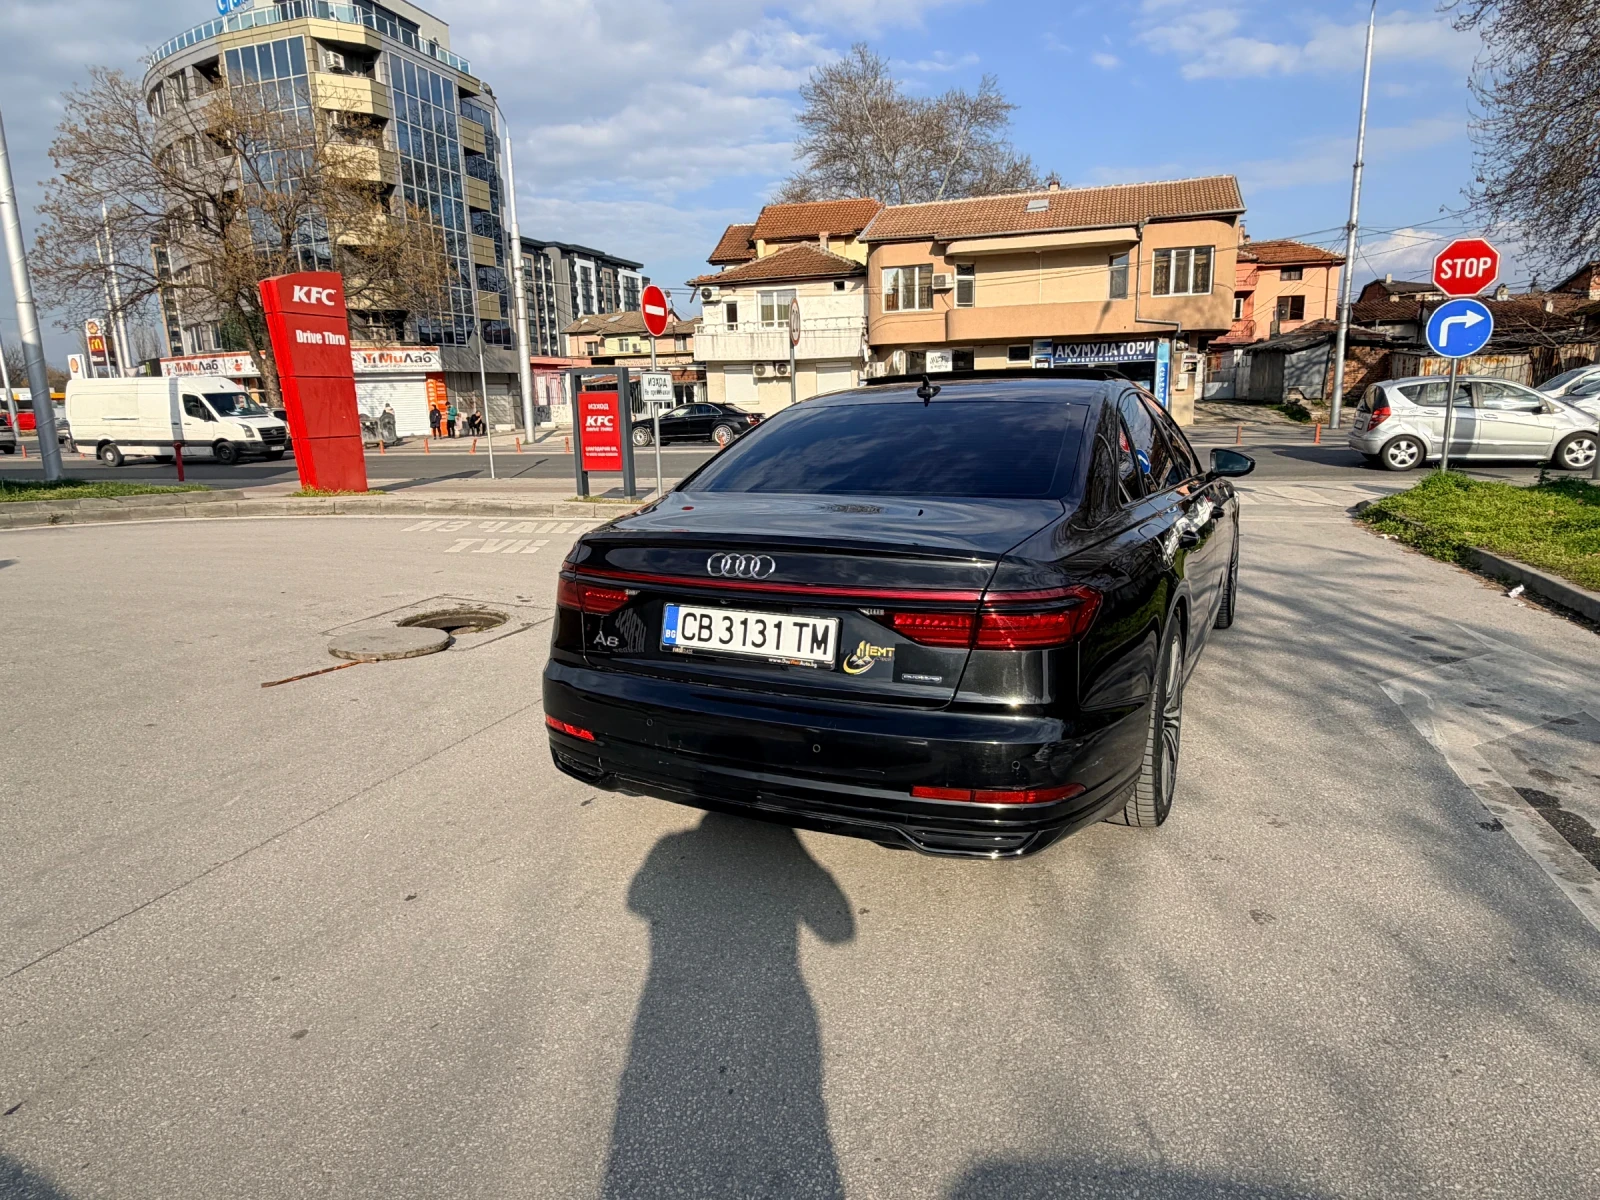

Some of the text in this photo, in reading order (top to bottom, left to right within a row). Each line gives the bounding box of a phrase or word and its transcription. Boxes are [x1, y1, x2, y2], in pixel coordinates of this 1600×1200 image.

[1440, 257, 1492, 279] STOP
[292, 285, 337, 306] KFC
[295, 329, 346, 346] Drive Thru
[1055, 341, 1155, 358] АКУМУЛАТОРИ
[585, 415, 614, 426] KFC
[593, 630, 620, 648] A8
[665, 630, 676, 639] BG
[681, 612, 713, 642] CB
[719, 616, 783, 650] 3131
[793, 622, 830, 655] TM
